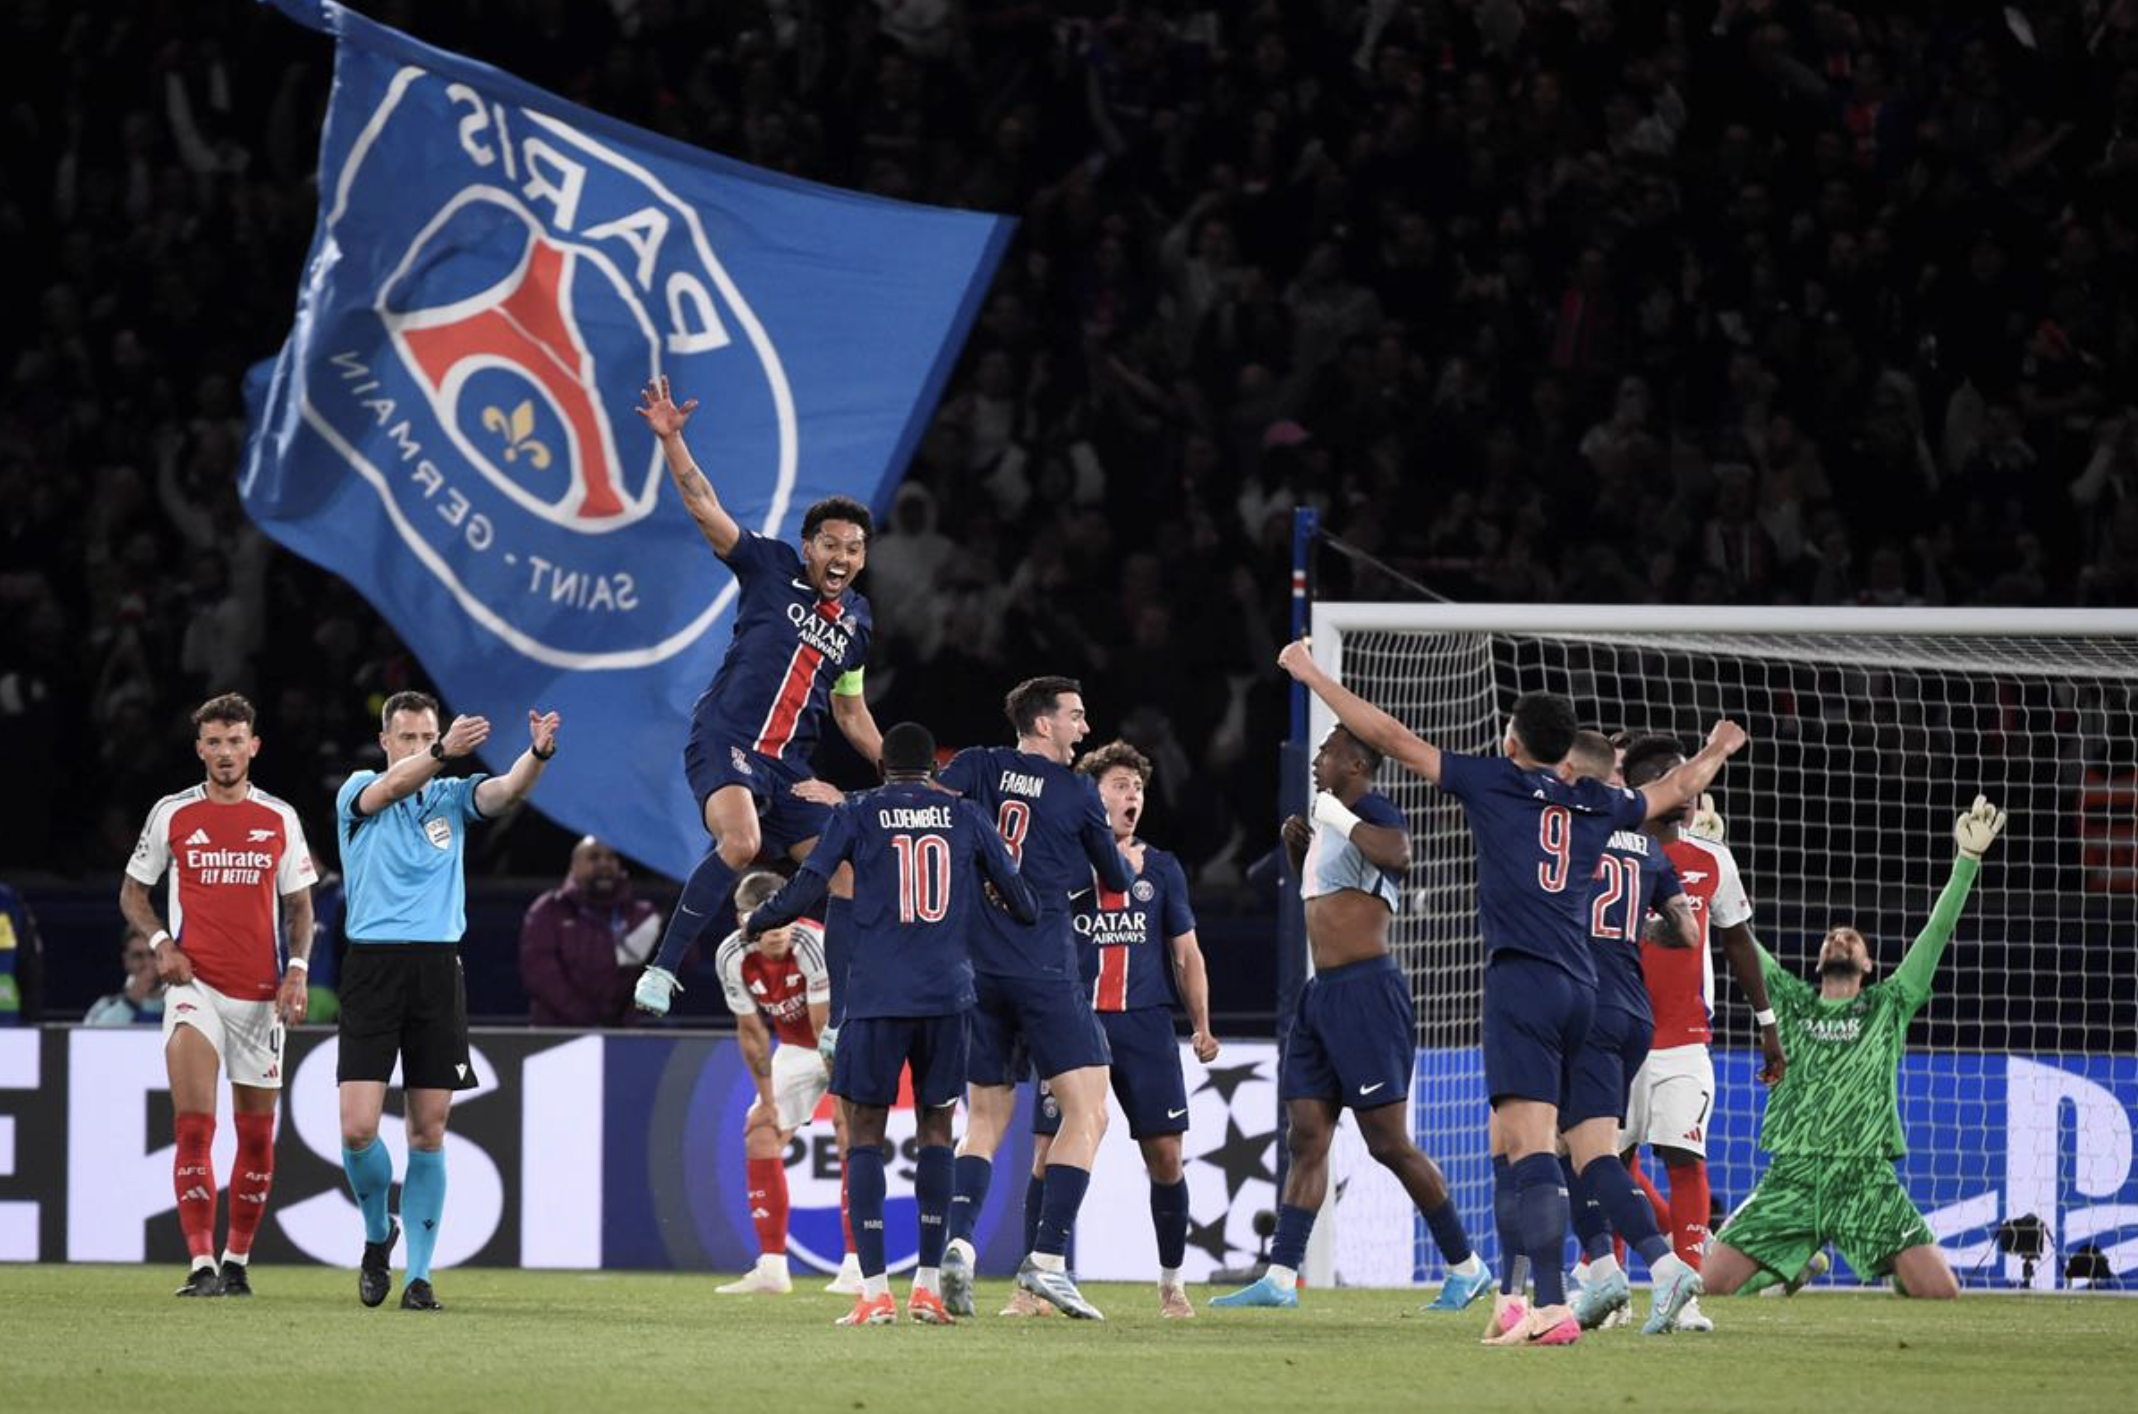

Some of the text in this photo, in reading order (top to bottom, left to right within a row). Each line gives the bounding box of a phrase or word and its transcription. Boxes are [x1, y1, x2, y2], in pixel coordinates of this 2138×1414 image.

[787, 603, 849, 653] QATAR
[798, 629, 844, 665] AIRWAYS
[998, 800, 1030, 870] 8
[1538, 805, 1571, 893] 9
[187, 849, 272, 869] Emirates
[201, 868, 261, 885] FLY BETTER
[891, 834, 951, 923] 10
[1591, 853, 1641, 943] 21
[1073, 912, 1146, 936] QATAR
[1092, 932, 1146, 944] AIRWAYS
[1697, 1090, 1710, 1124] 7
[177, 1165, 207, 1176] AFC
